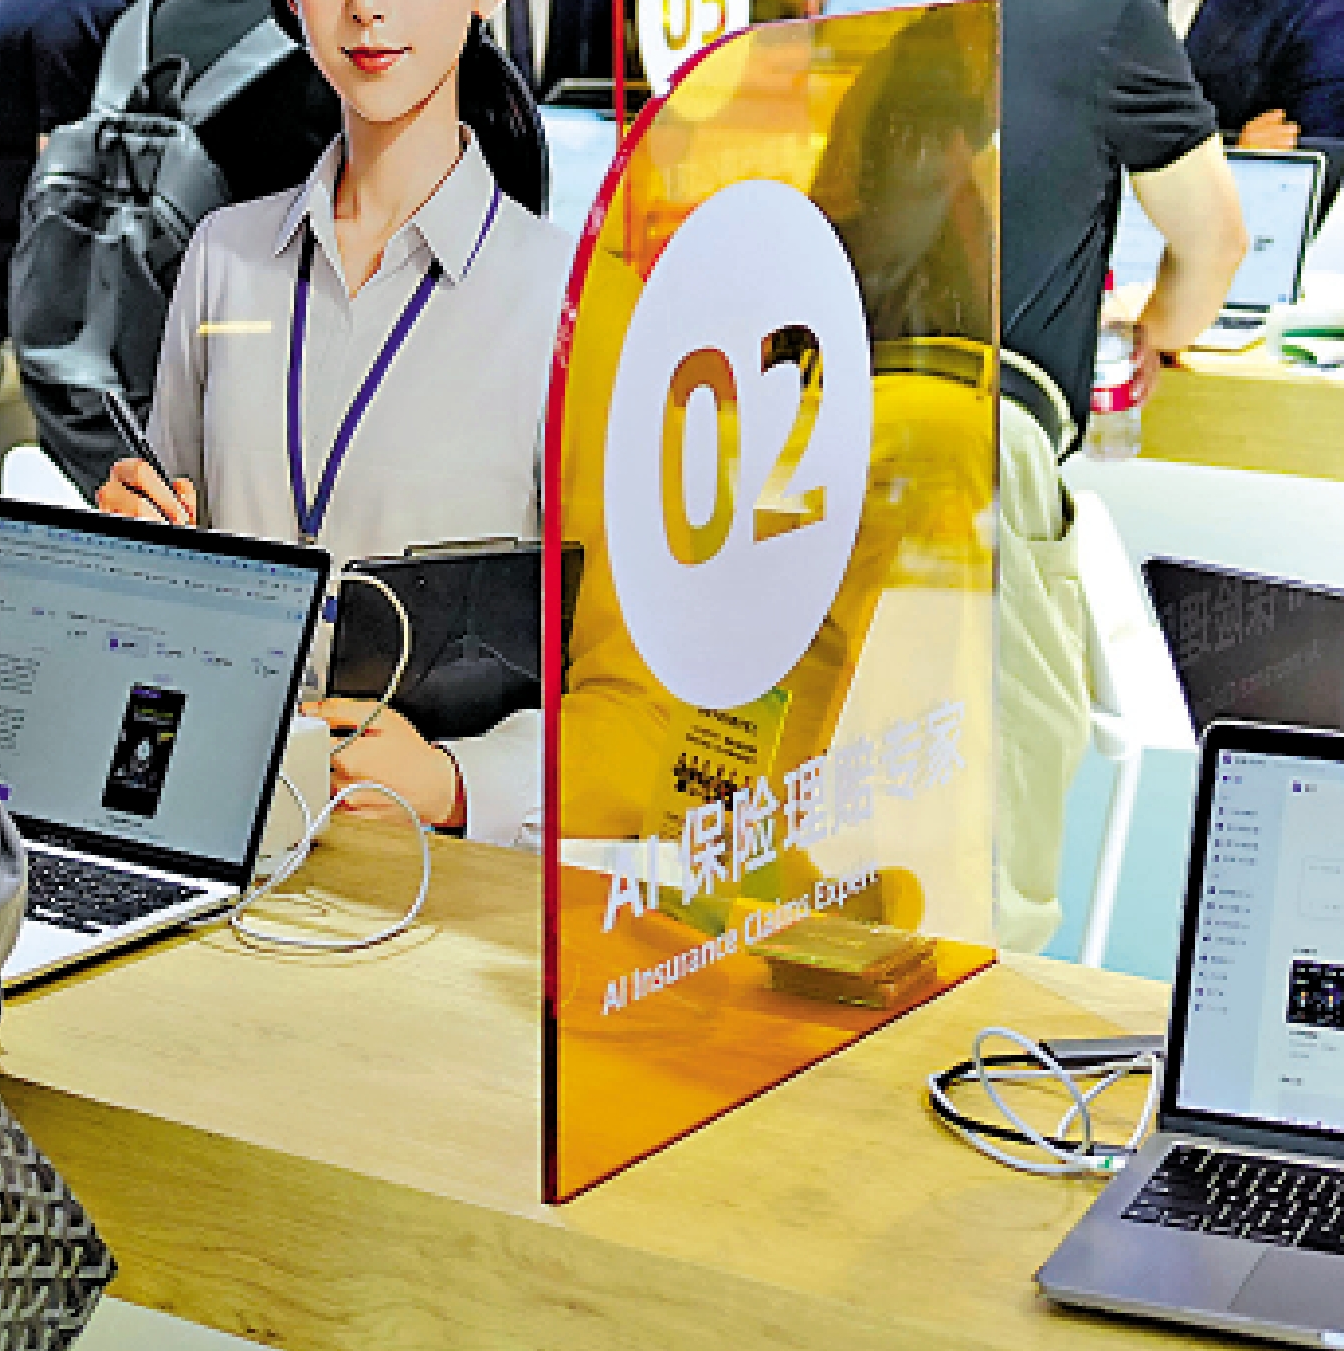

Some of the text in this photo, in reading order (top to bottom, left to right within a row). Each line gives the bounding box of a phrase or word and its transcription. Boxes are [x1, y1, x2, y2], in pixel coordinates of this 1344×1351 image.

[661, 324, 826, 566] 02
[601, 856, 880, 1017] AI Insurance Claims Expert
